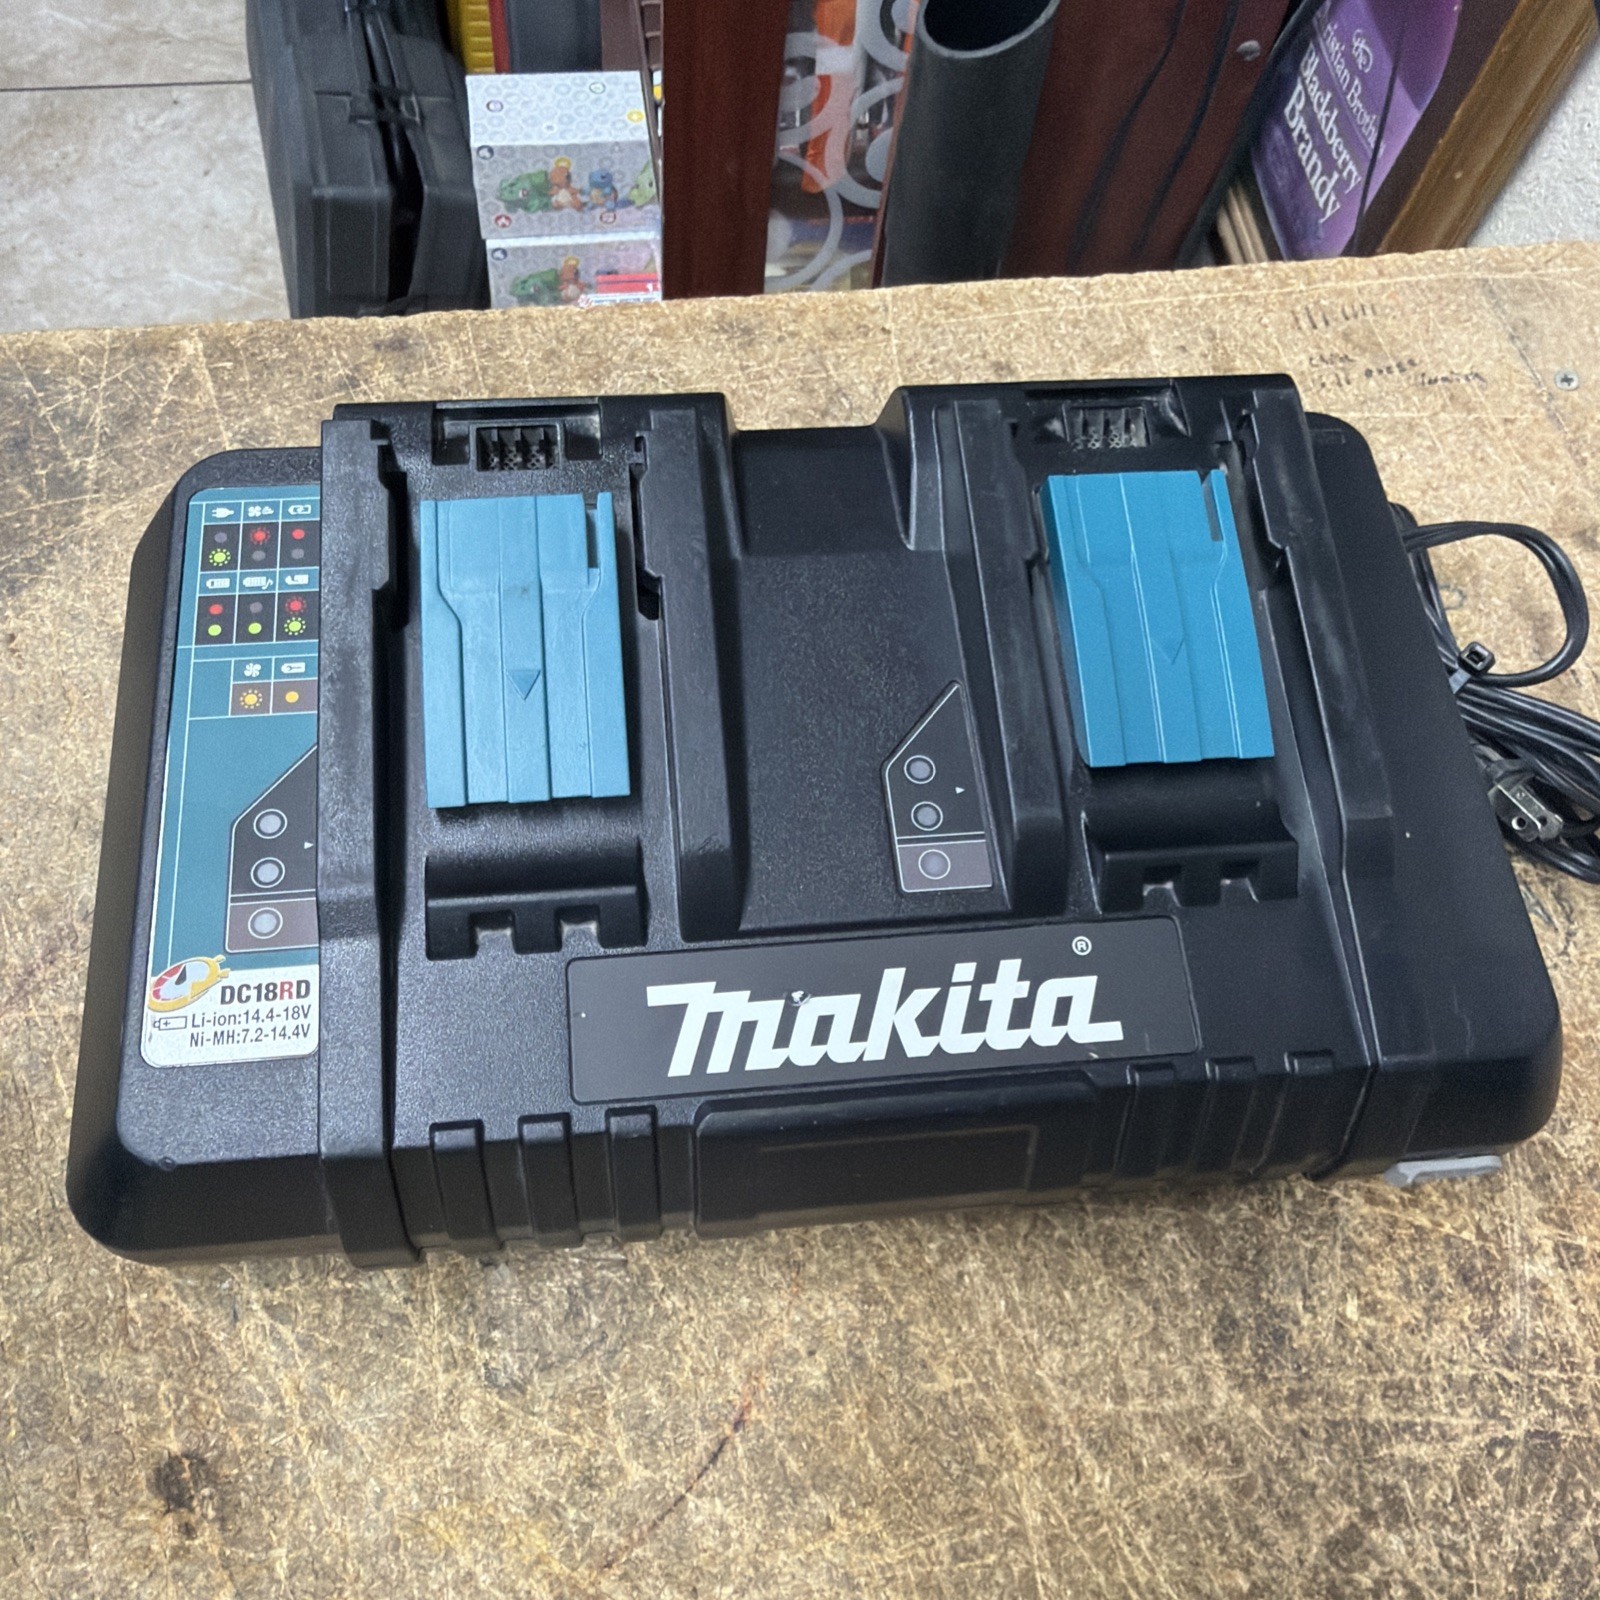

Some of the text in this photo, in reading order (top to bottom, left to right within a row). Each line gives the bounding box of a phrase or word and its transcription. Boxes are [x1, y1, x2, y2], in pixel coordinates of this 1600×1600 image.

[1321, 21, 1350, 91] ristian
[1300, 42, 1362, 194] Blackberry
[1284, 76, 1341, 223] Brandy
[220, 979, 311, 1005] DC18RD
[189, 1024, 311, 1048] Ni-MH:7.2-14.4V
[191, 1004, 312, 1029] Li-ion:14.4-18V
